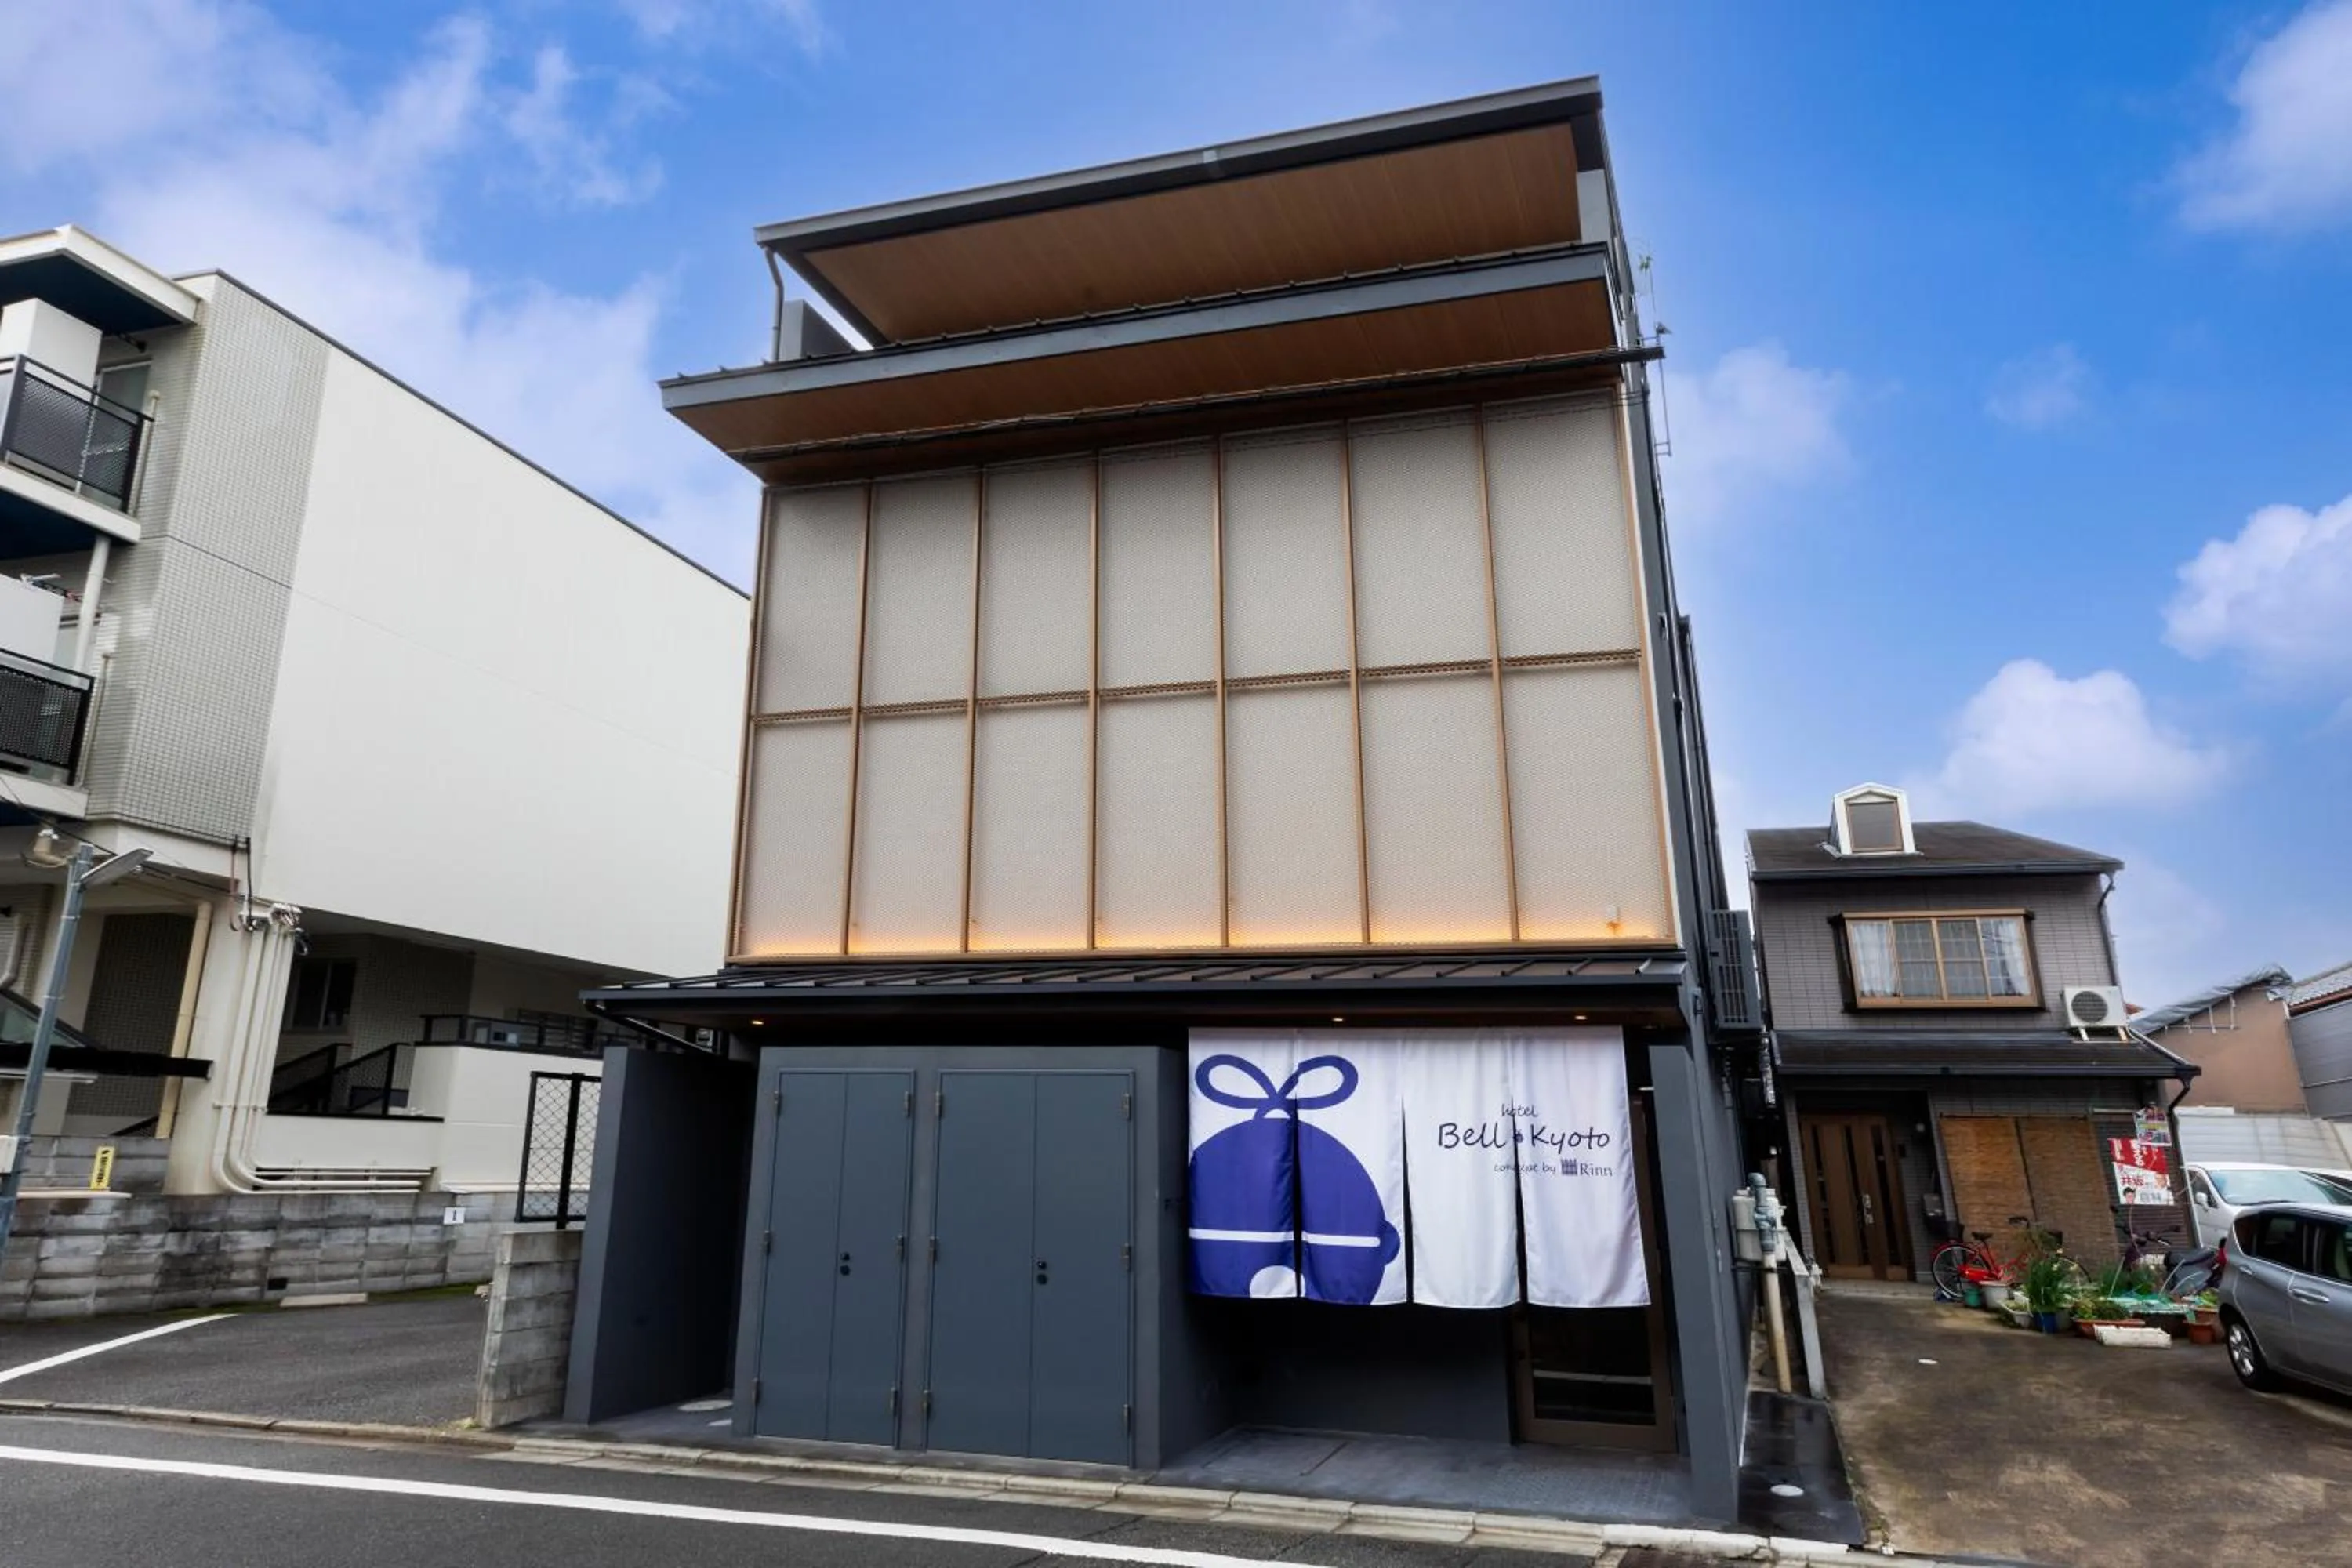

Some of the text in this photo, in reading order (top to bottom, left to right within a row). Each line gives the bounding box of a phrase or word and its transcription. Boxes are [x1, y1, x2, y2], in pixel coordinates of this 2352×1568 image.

[1501, 1103, 1538, 1117] hotel
[1438, 1122, 1610, 1154] Bell Kyoto
[1494, 1161, 1613, 1176] conept by Rinn
